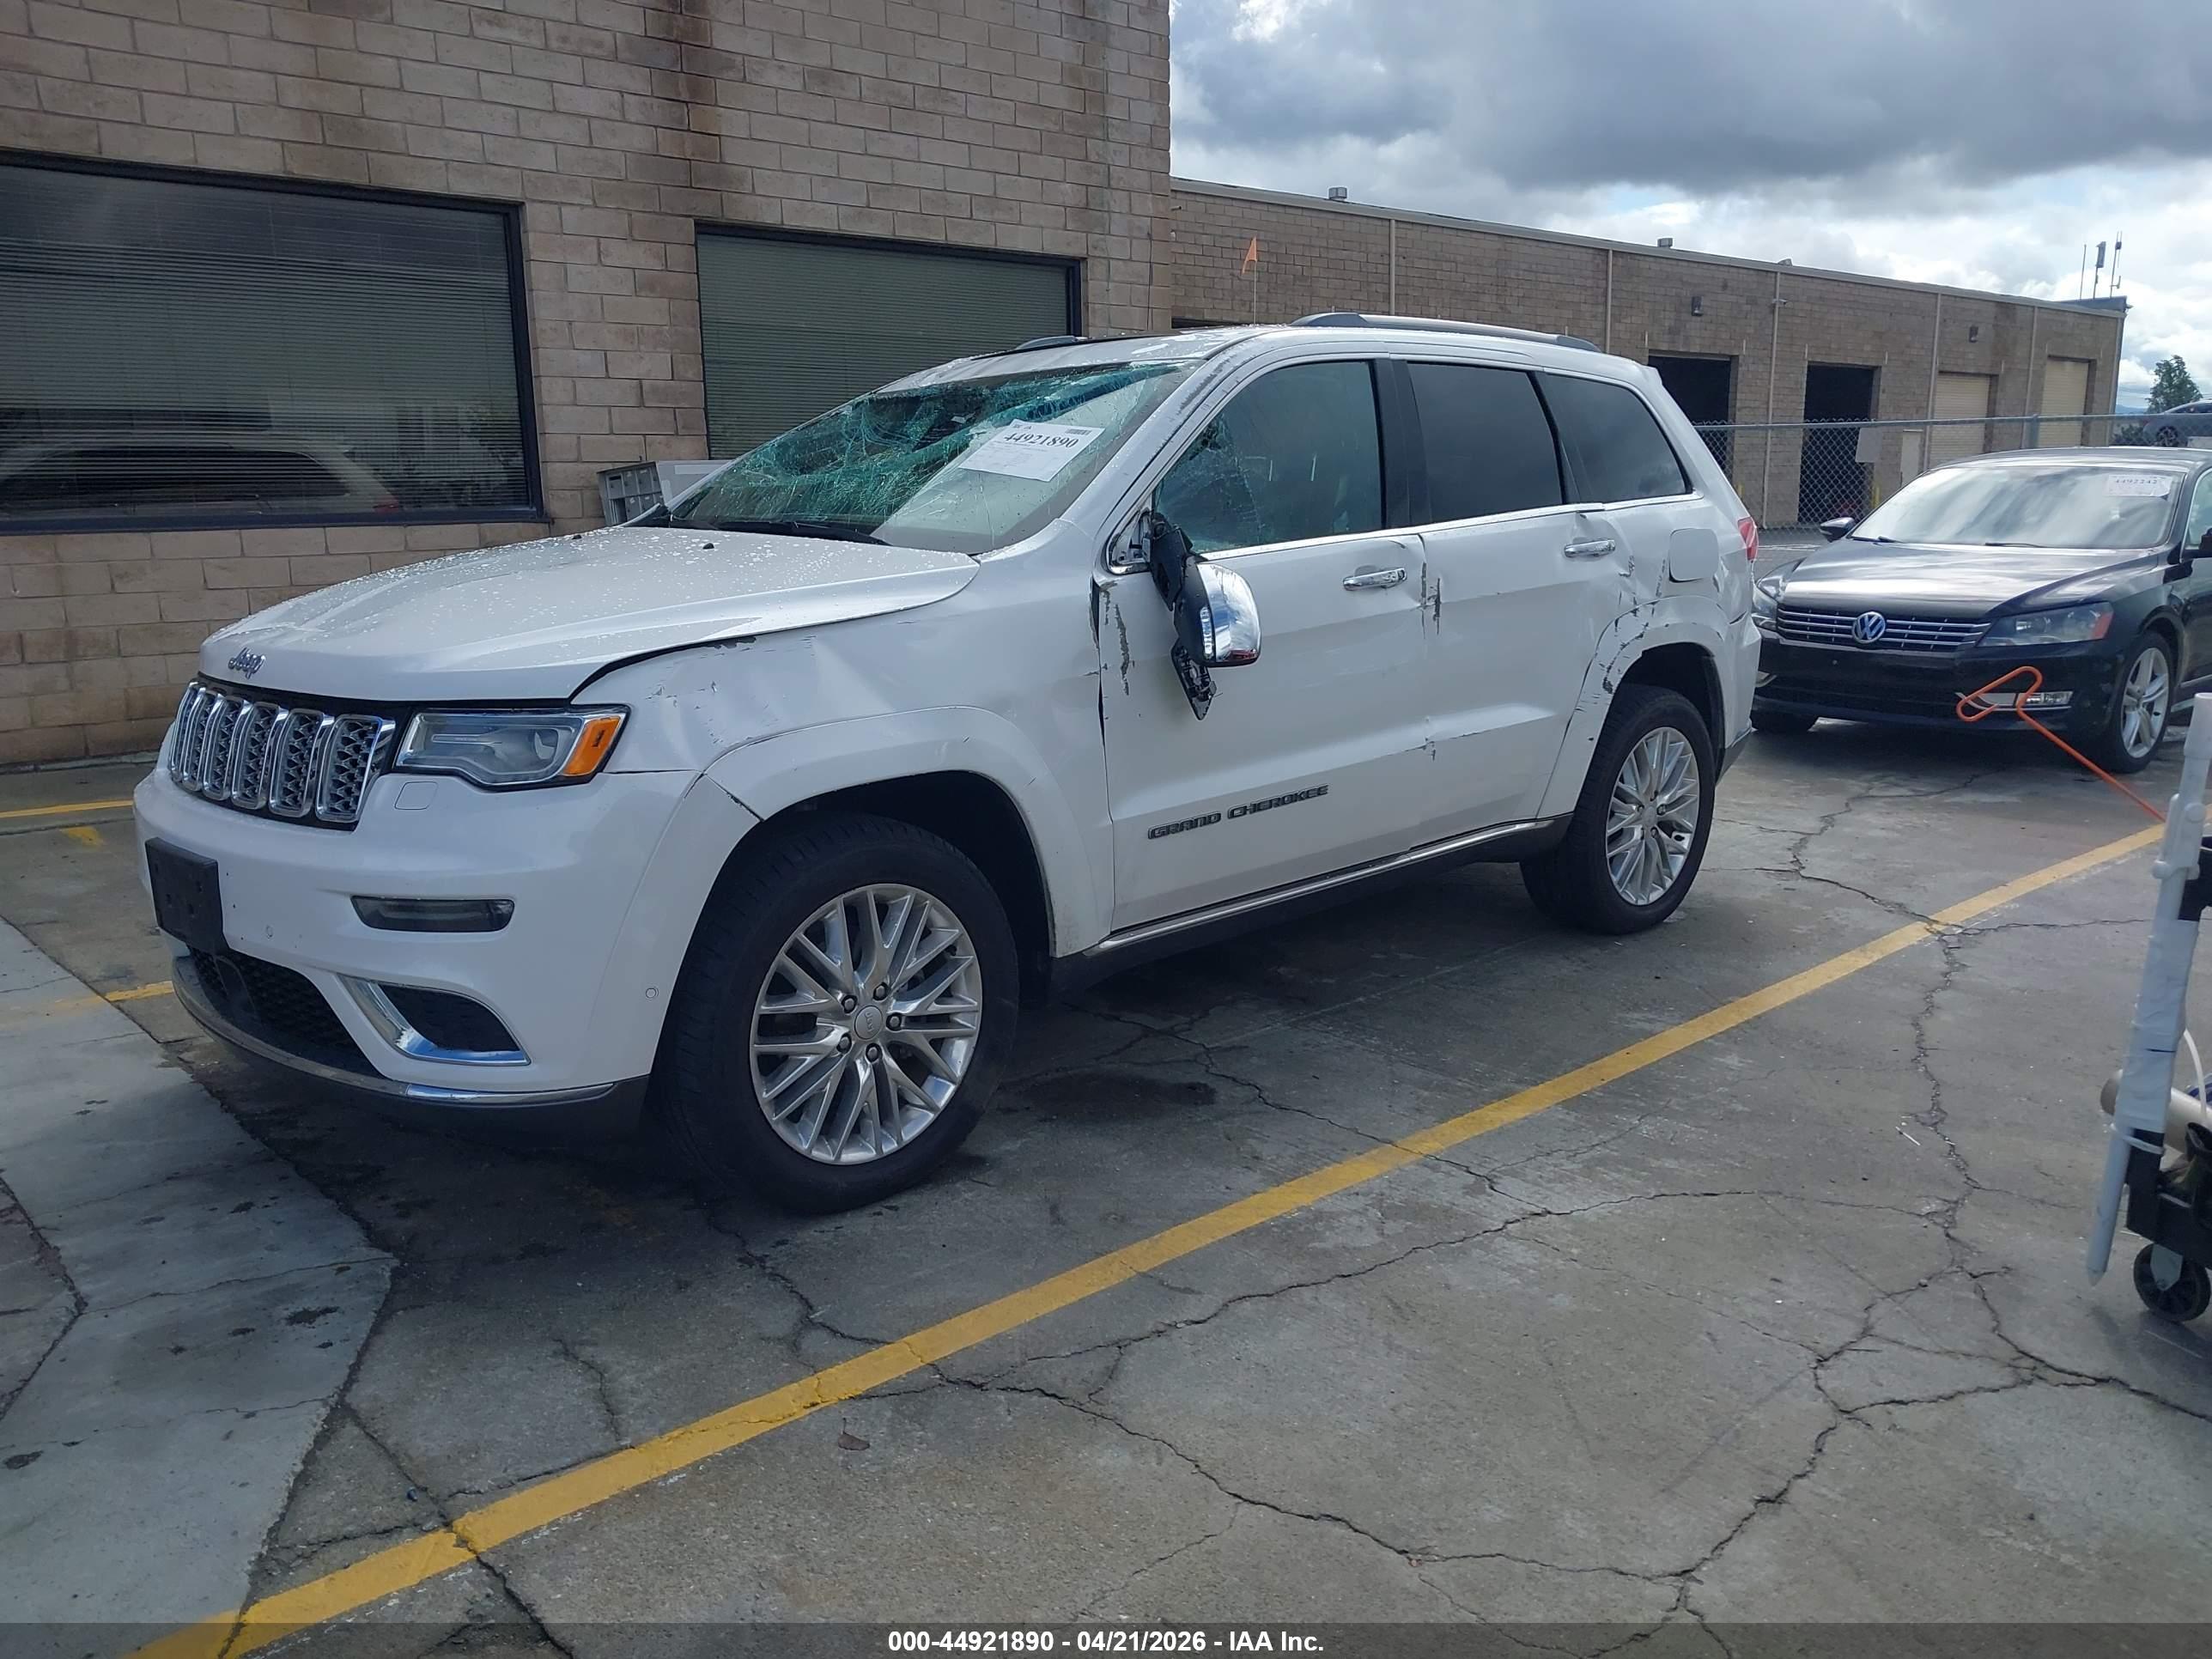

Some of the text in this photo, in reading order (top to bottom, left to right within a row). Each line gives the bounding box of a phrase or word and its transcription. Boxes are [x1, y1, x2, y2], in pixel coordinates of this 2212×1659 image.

[1003, 432, 1079, 448] 44921890
[1854, 612, 1885, 642] VW
[228, 647, 266, 679] Jeep
[1147, 784, 1329, 840] GRAND CHEROKEE
